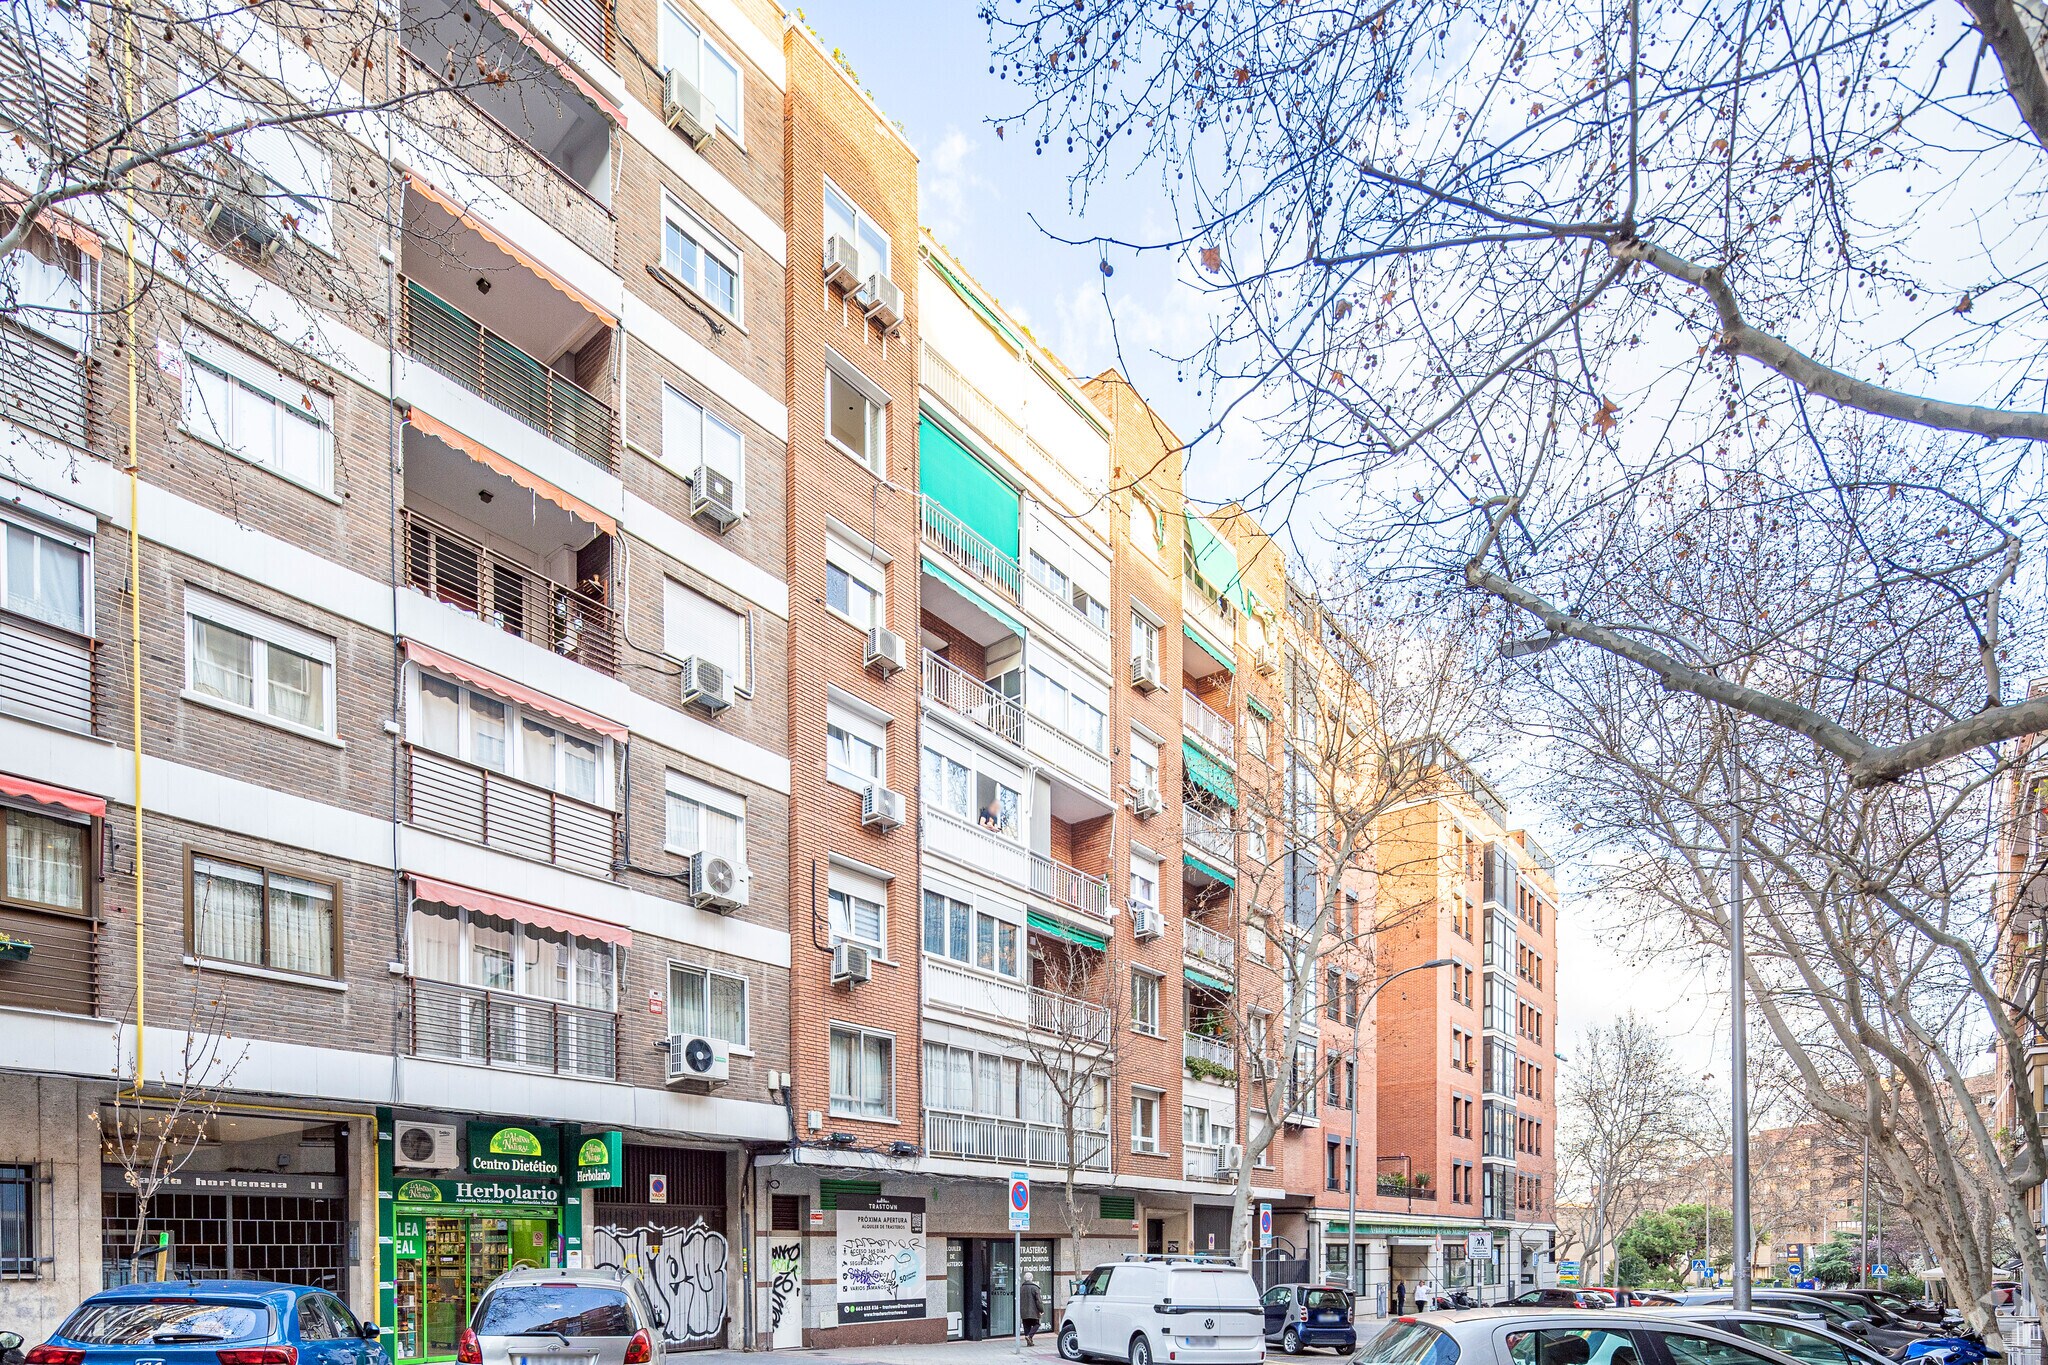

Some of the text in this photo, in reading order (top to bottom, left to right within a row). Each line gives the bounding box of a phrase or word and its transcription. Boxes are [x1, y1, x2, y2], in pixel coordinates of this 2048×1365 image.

[473, 1157, 557, 1173] Centro Dietético
[577, 1168, 610, 1182] Herbolario
[196, 1178, 287, 1189] hortensia
[456, 1183, 557, 1200] Herbolario
[397, 1222, 419, 1236] LEA
[396, 1240, 416, 1254] EAL
[900, 1275, 906, 1283] 50
